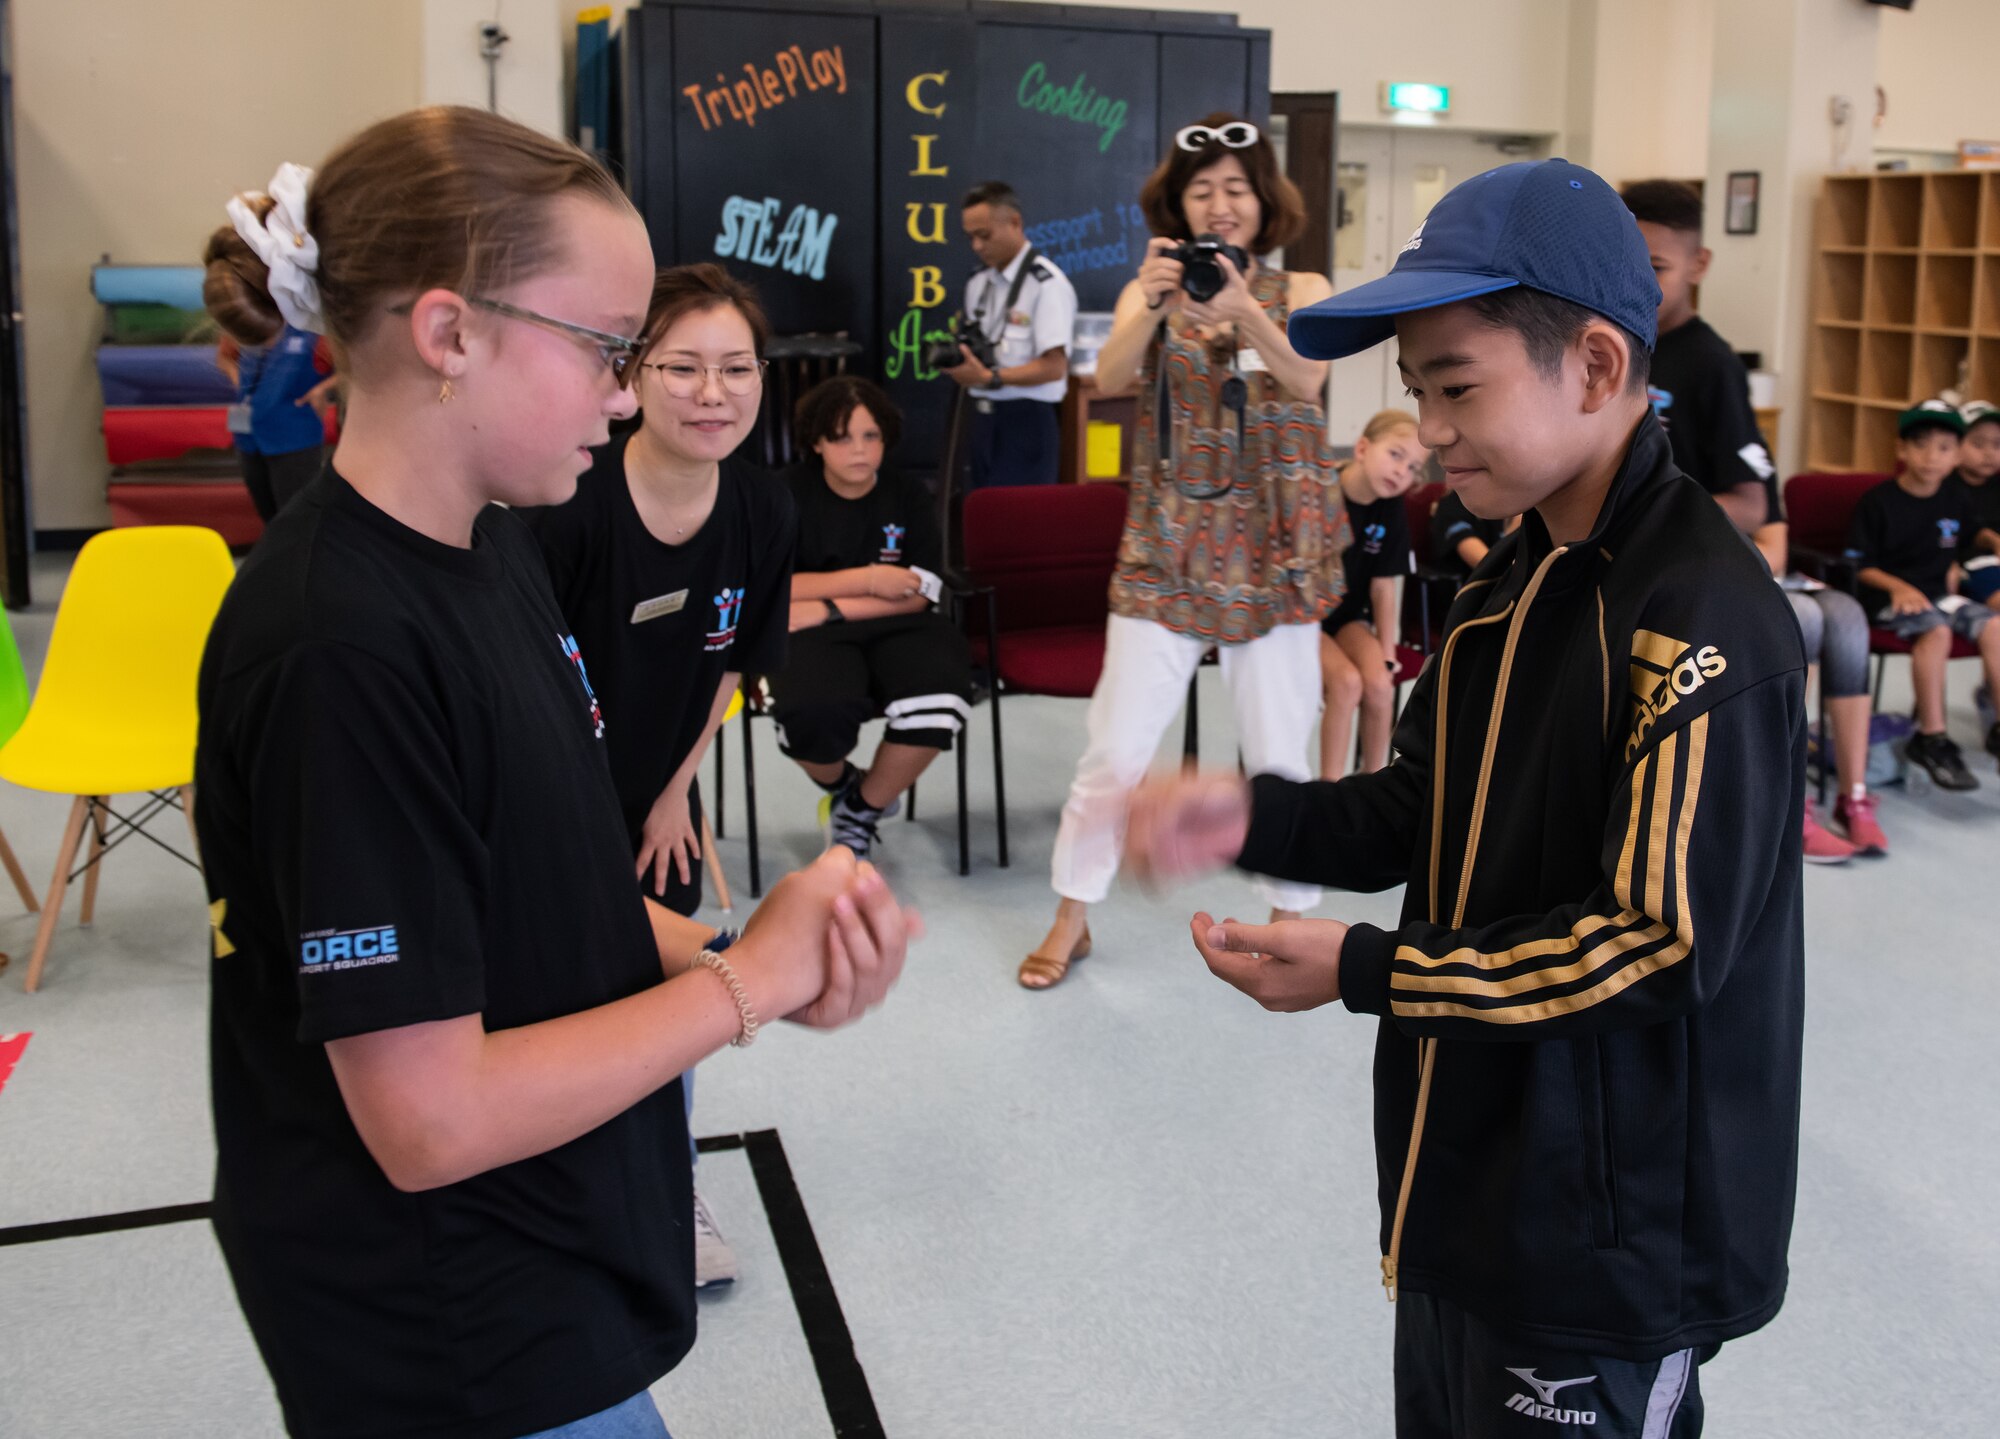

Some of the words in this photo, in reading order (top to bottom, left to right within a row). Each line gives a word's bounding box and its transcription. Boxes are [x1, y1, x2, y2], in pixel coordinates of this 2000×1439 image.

[1018, 62, 1128, 153] Cooking
[714, 195, 838, 281] STEAM
[333, 954, 398, 970] SQUADRON
[1504, 1392, 1597, 1425] MIZUNO
